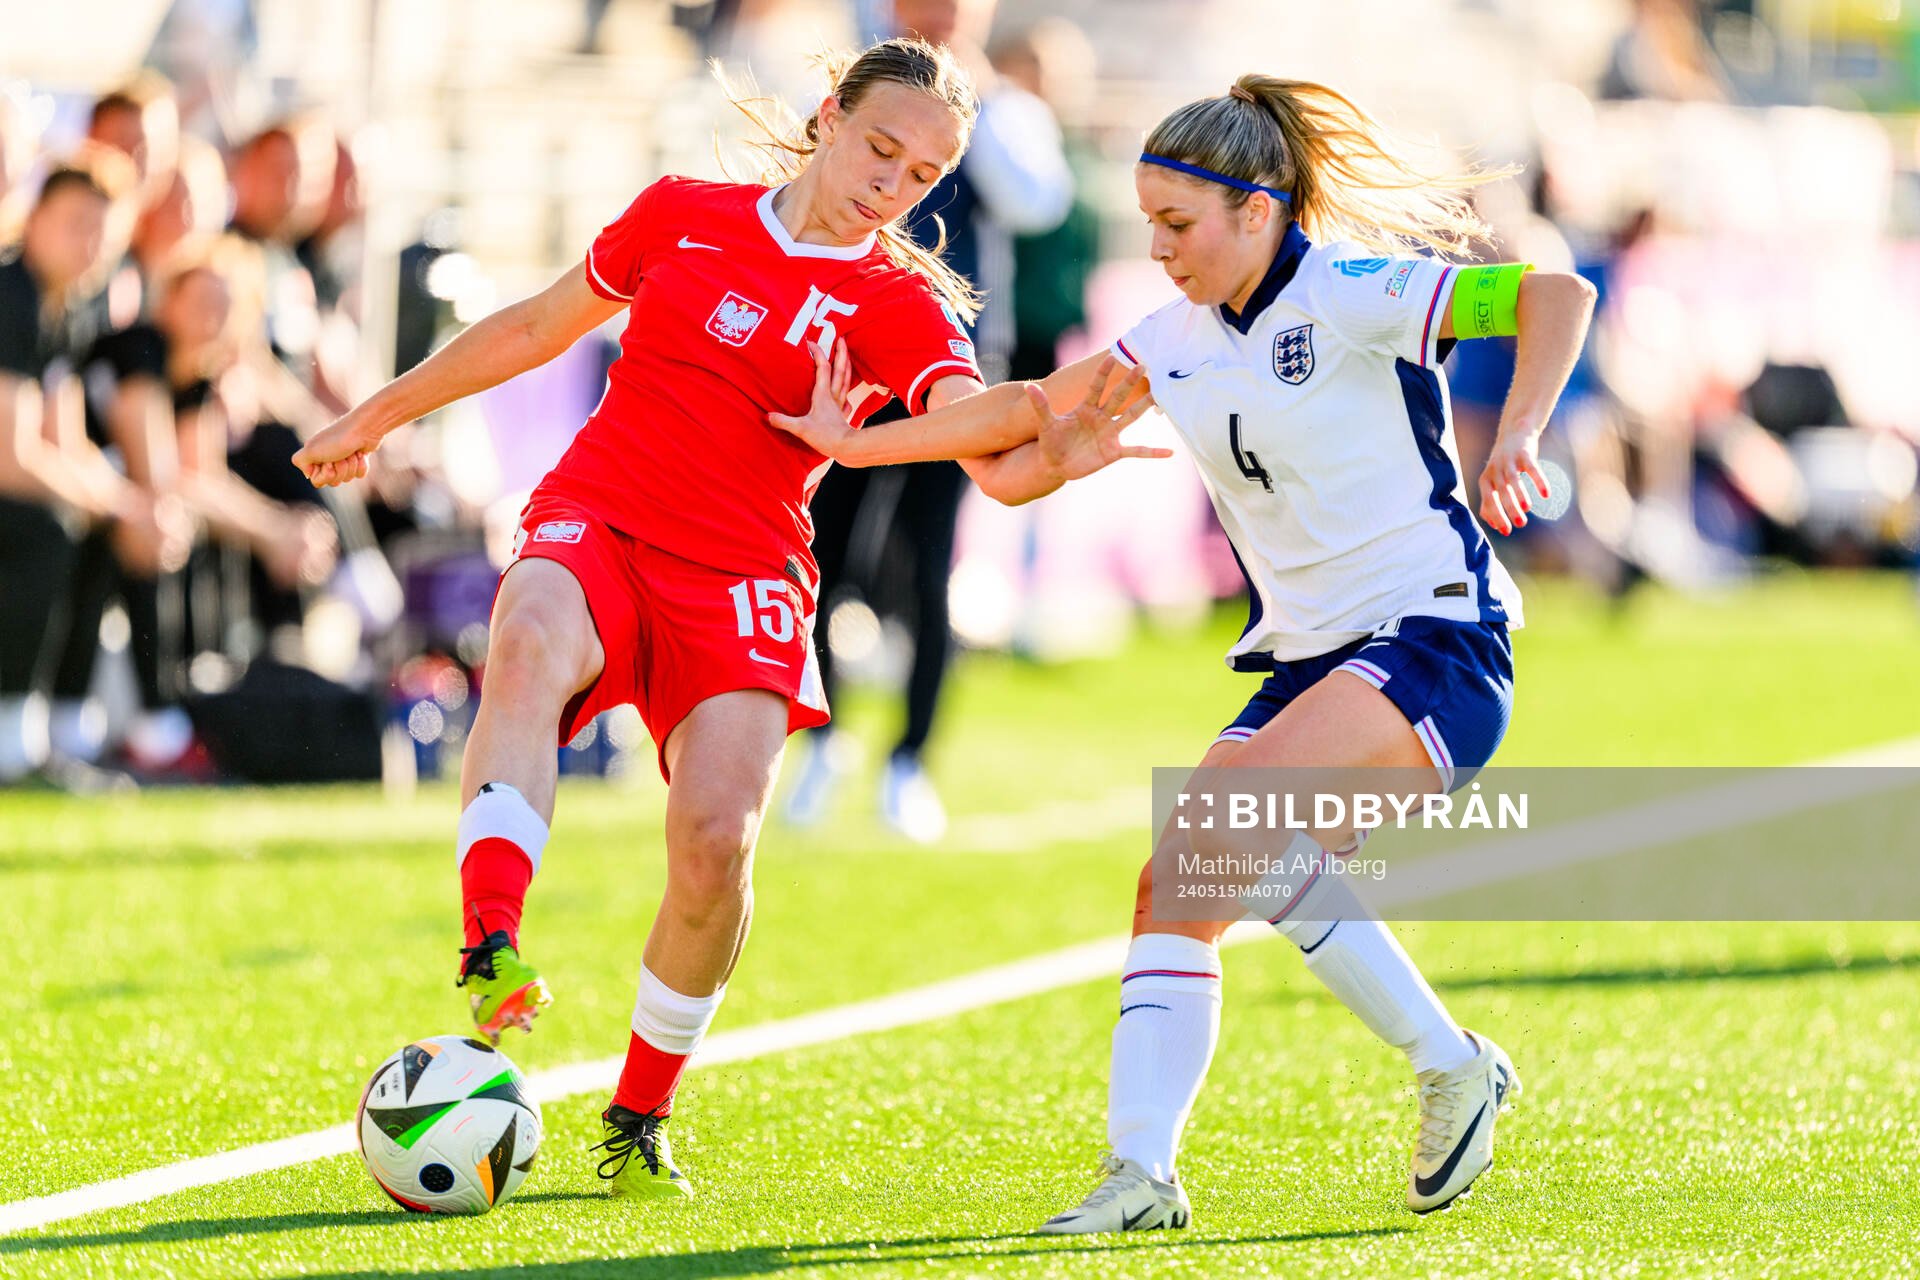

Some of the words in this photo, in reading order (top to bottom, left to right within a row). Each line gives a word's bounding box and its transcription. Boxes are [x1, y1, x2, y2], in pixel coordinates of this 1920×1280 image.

[783, 284, 859, 361] 15
[1229, 413, 1274, 493] 4
[728, 579, 794, 643] 15
